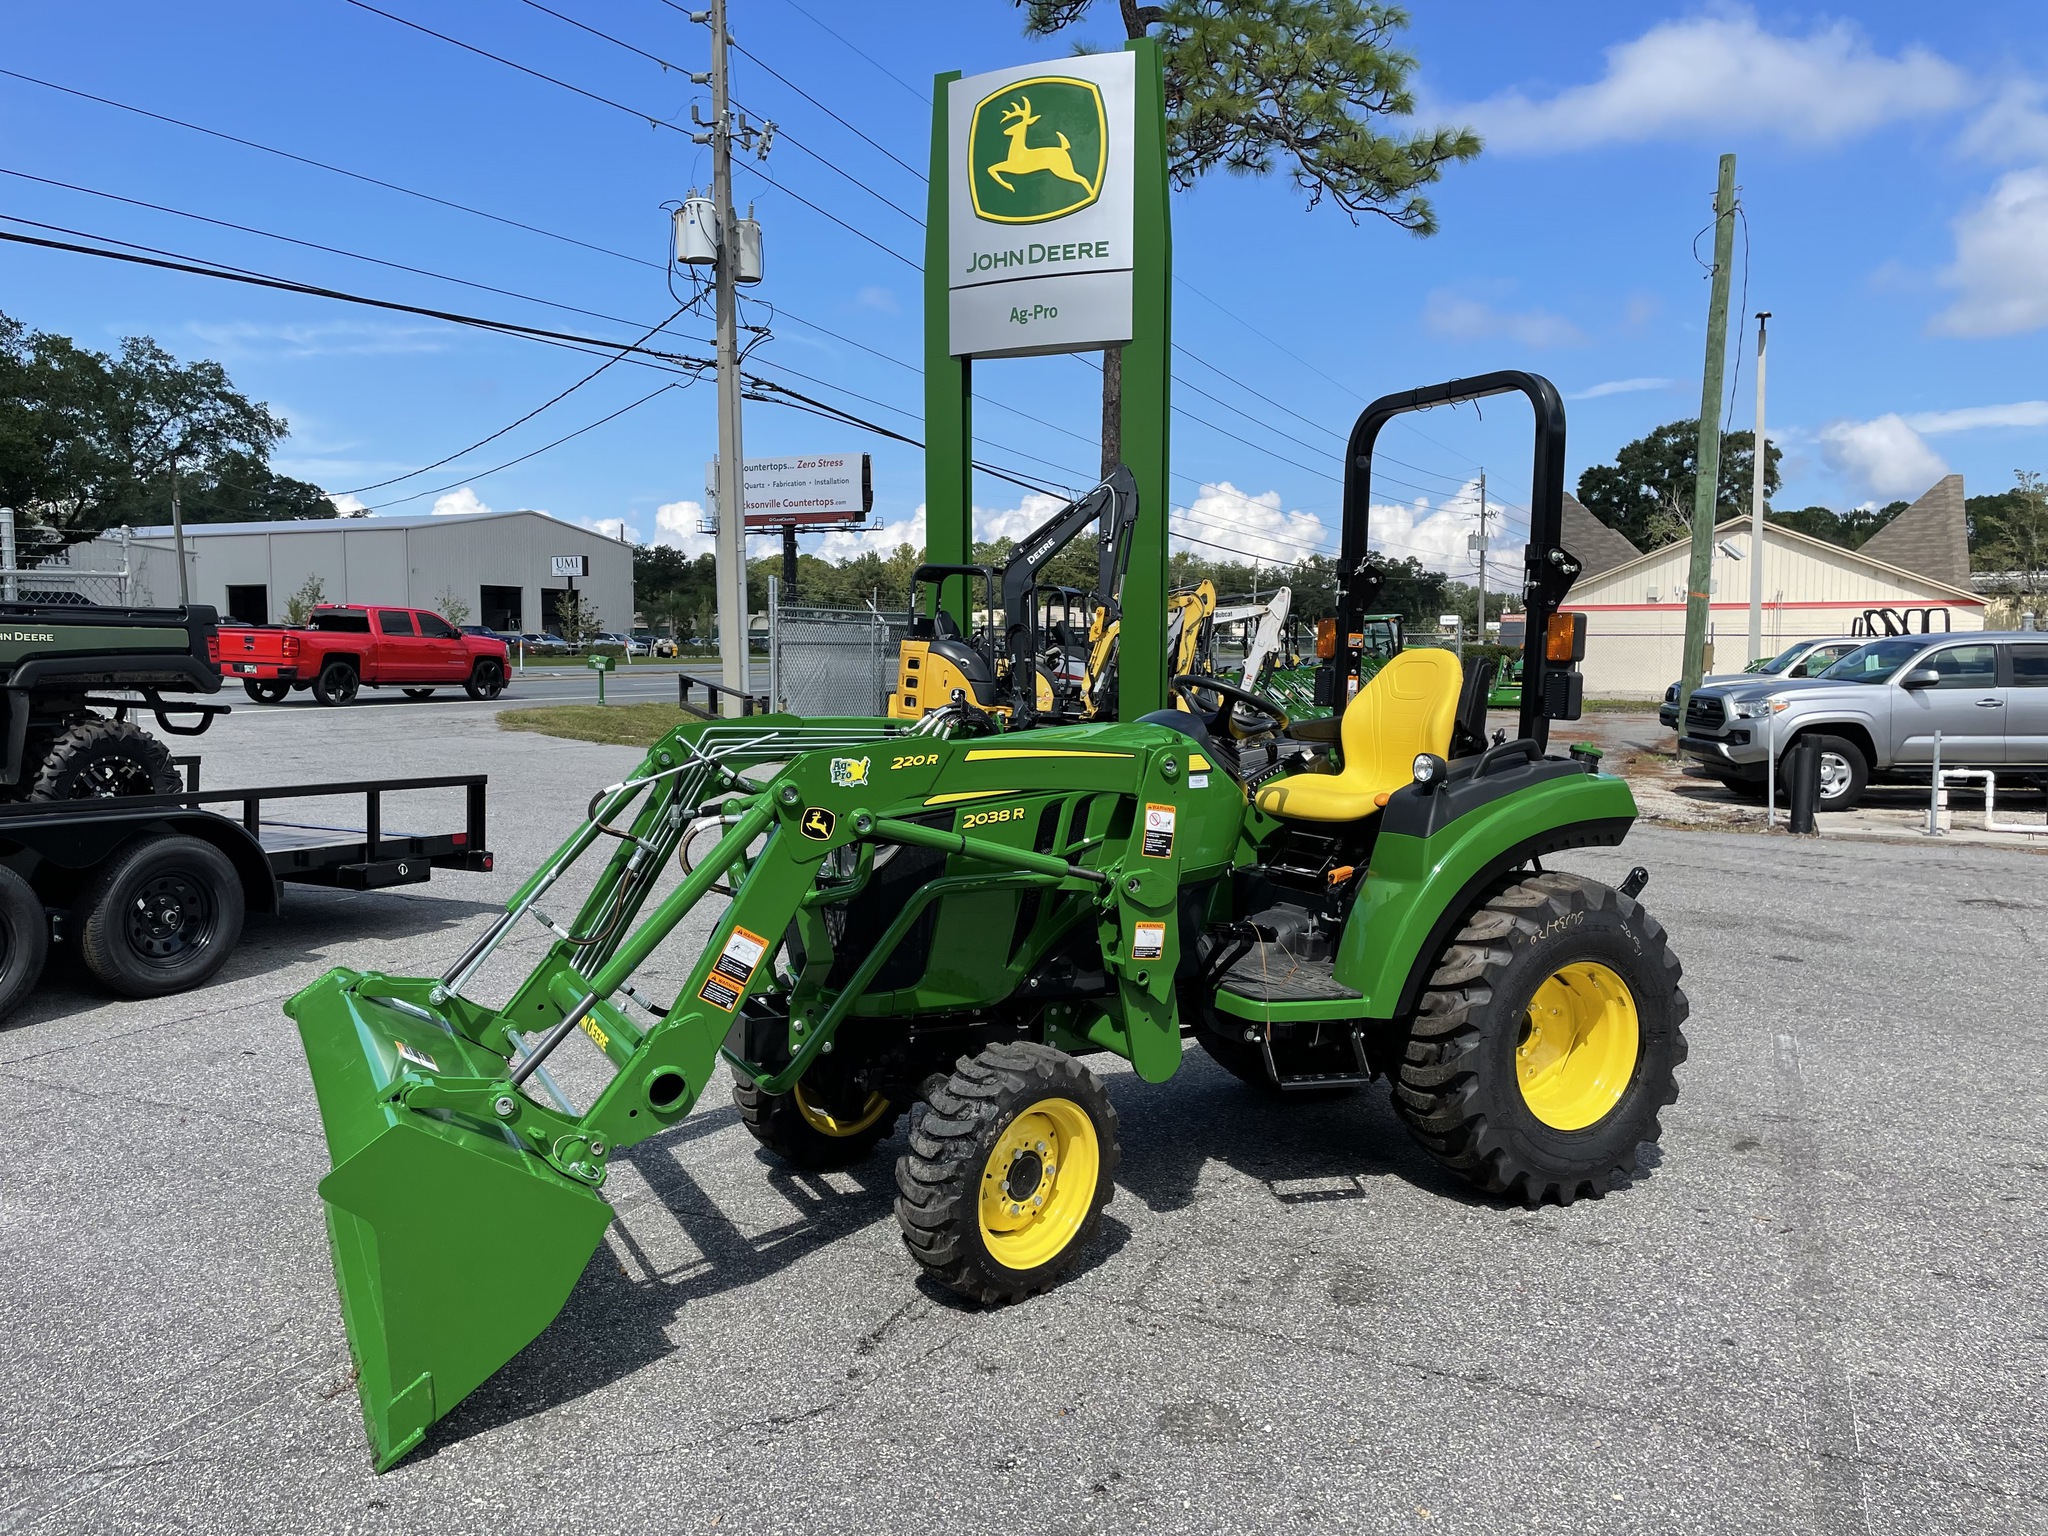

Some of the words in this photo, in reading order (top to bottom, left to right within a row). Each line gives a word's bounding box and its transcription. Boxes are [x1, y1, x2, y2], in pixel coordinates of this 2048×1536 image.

[966, 249, 1023, 273] JOHN
[1028, 241, 1109, 264] DEERE
[1009, 304, 1058, 324] Ag-Pro
[743, 463, 794, 472] ountertops...
[797, 460, 816, 469] Zero
[818, 459, 844, 468] Stress
[772, 480, 806, 488] Fabrication
[814, 478, 850, 486] Installation
[1027, 538, 1055, 565] DEERE
[556, 557, 578, 568] UMI
[14, 631, 54, 642] DEERE
[890, 755, 926, 770] 220
[834, 770, 852, 780] Pro
[1152, 804, 1175, 813] WARNING
[962, 809, 1011, 829] 2038
[742, 930, 765, 946] WARNING
[718, 977, 740, 992] WARNING
[587, 1018, 609, 1053] DEERE
